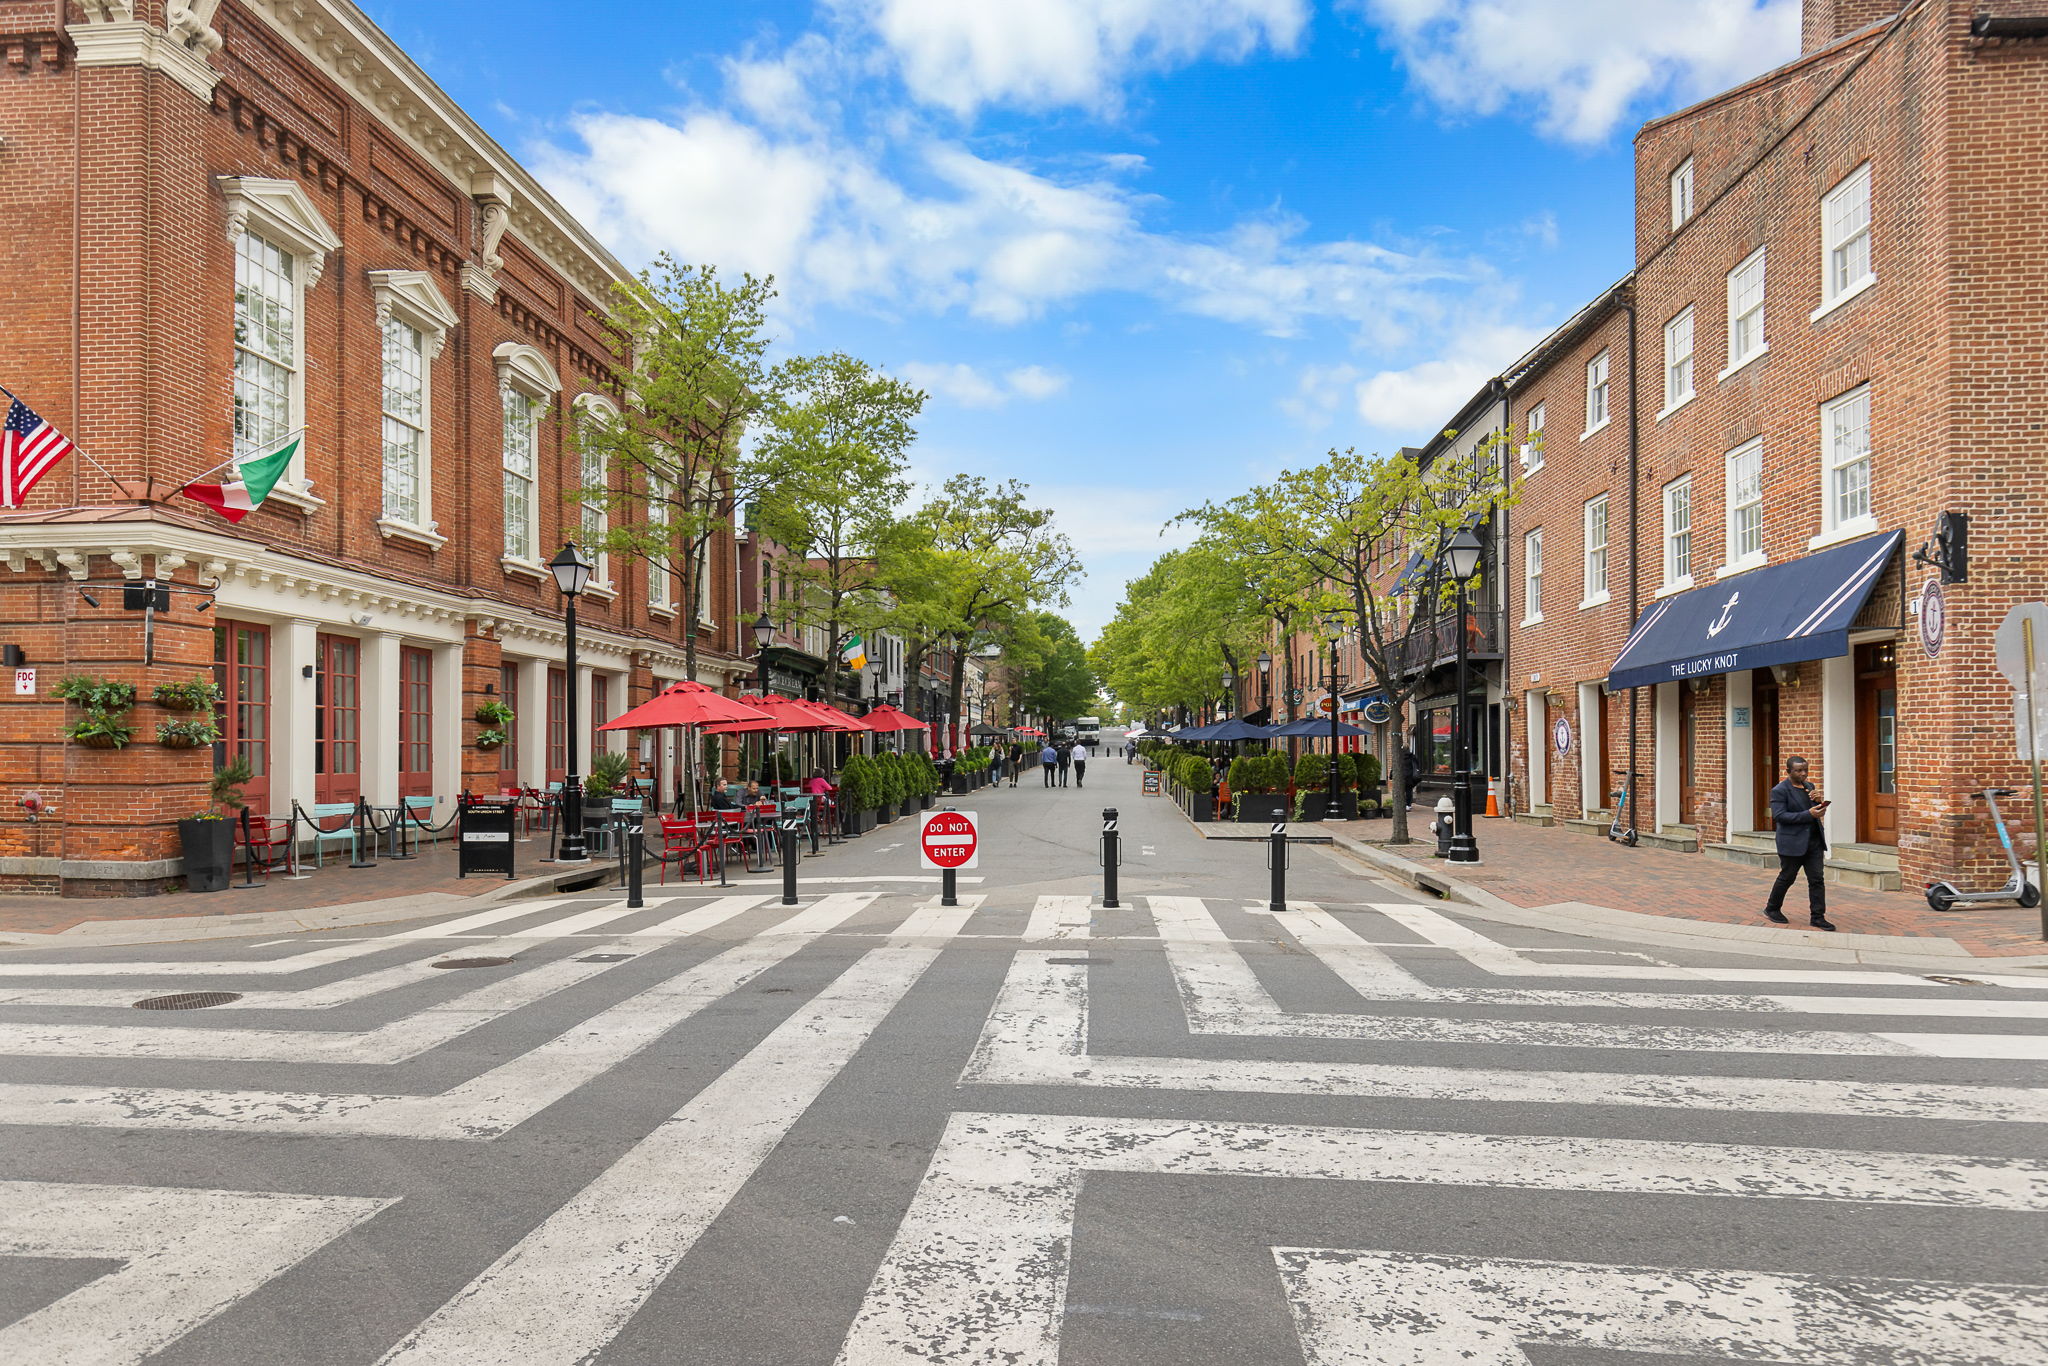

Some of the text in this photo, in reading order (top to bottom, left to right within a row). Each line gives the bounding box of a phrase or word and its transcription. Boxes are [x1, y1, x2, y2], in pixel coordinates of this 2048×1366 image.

[1671, 653, 1738, 676] THE LUCKY KNOT
[17, 671, 34, 681] FDC
[930, 822, 969, 832] DO NOT
[934, 847, 965, 857] ENTER
